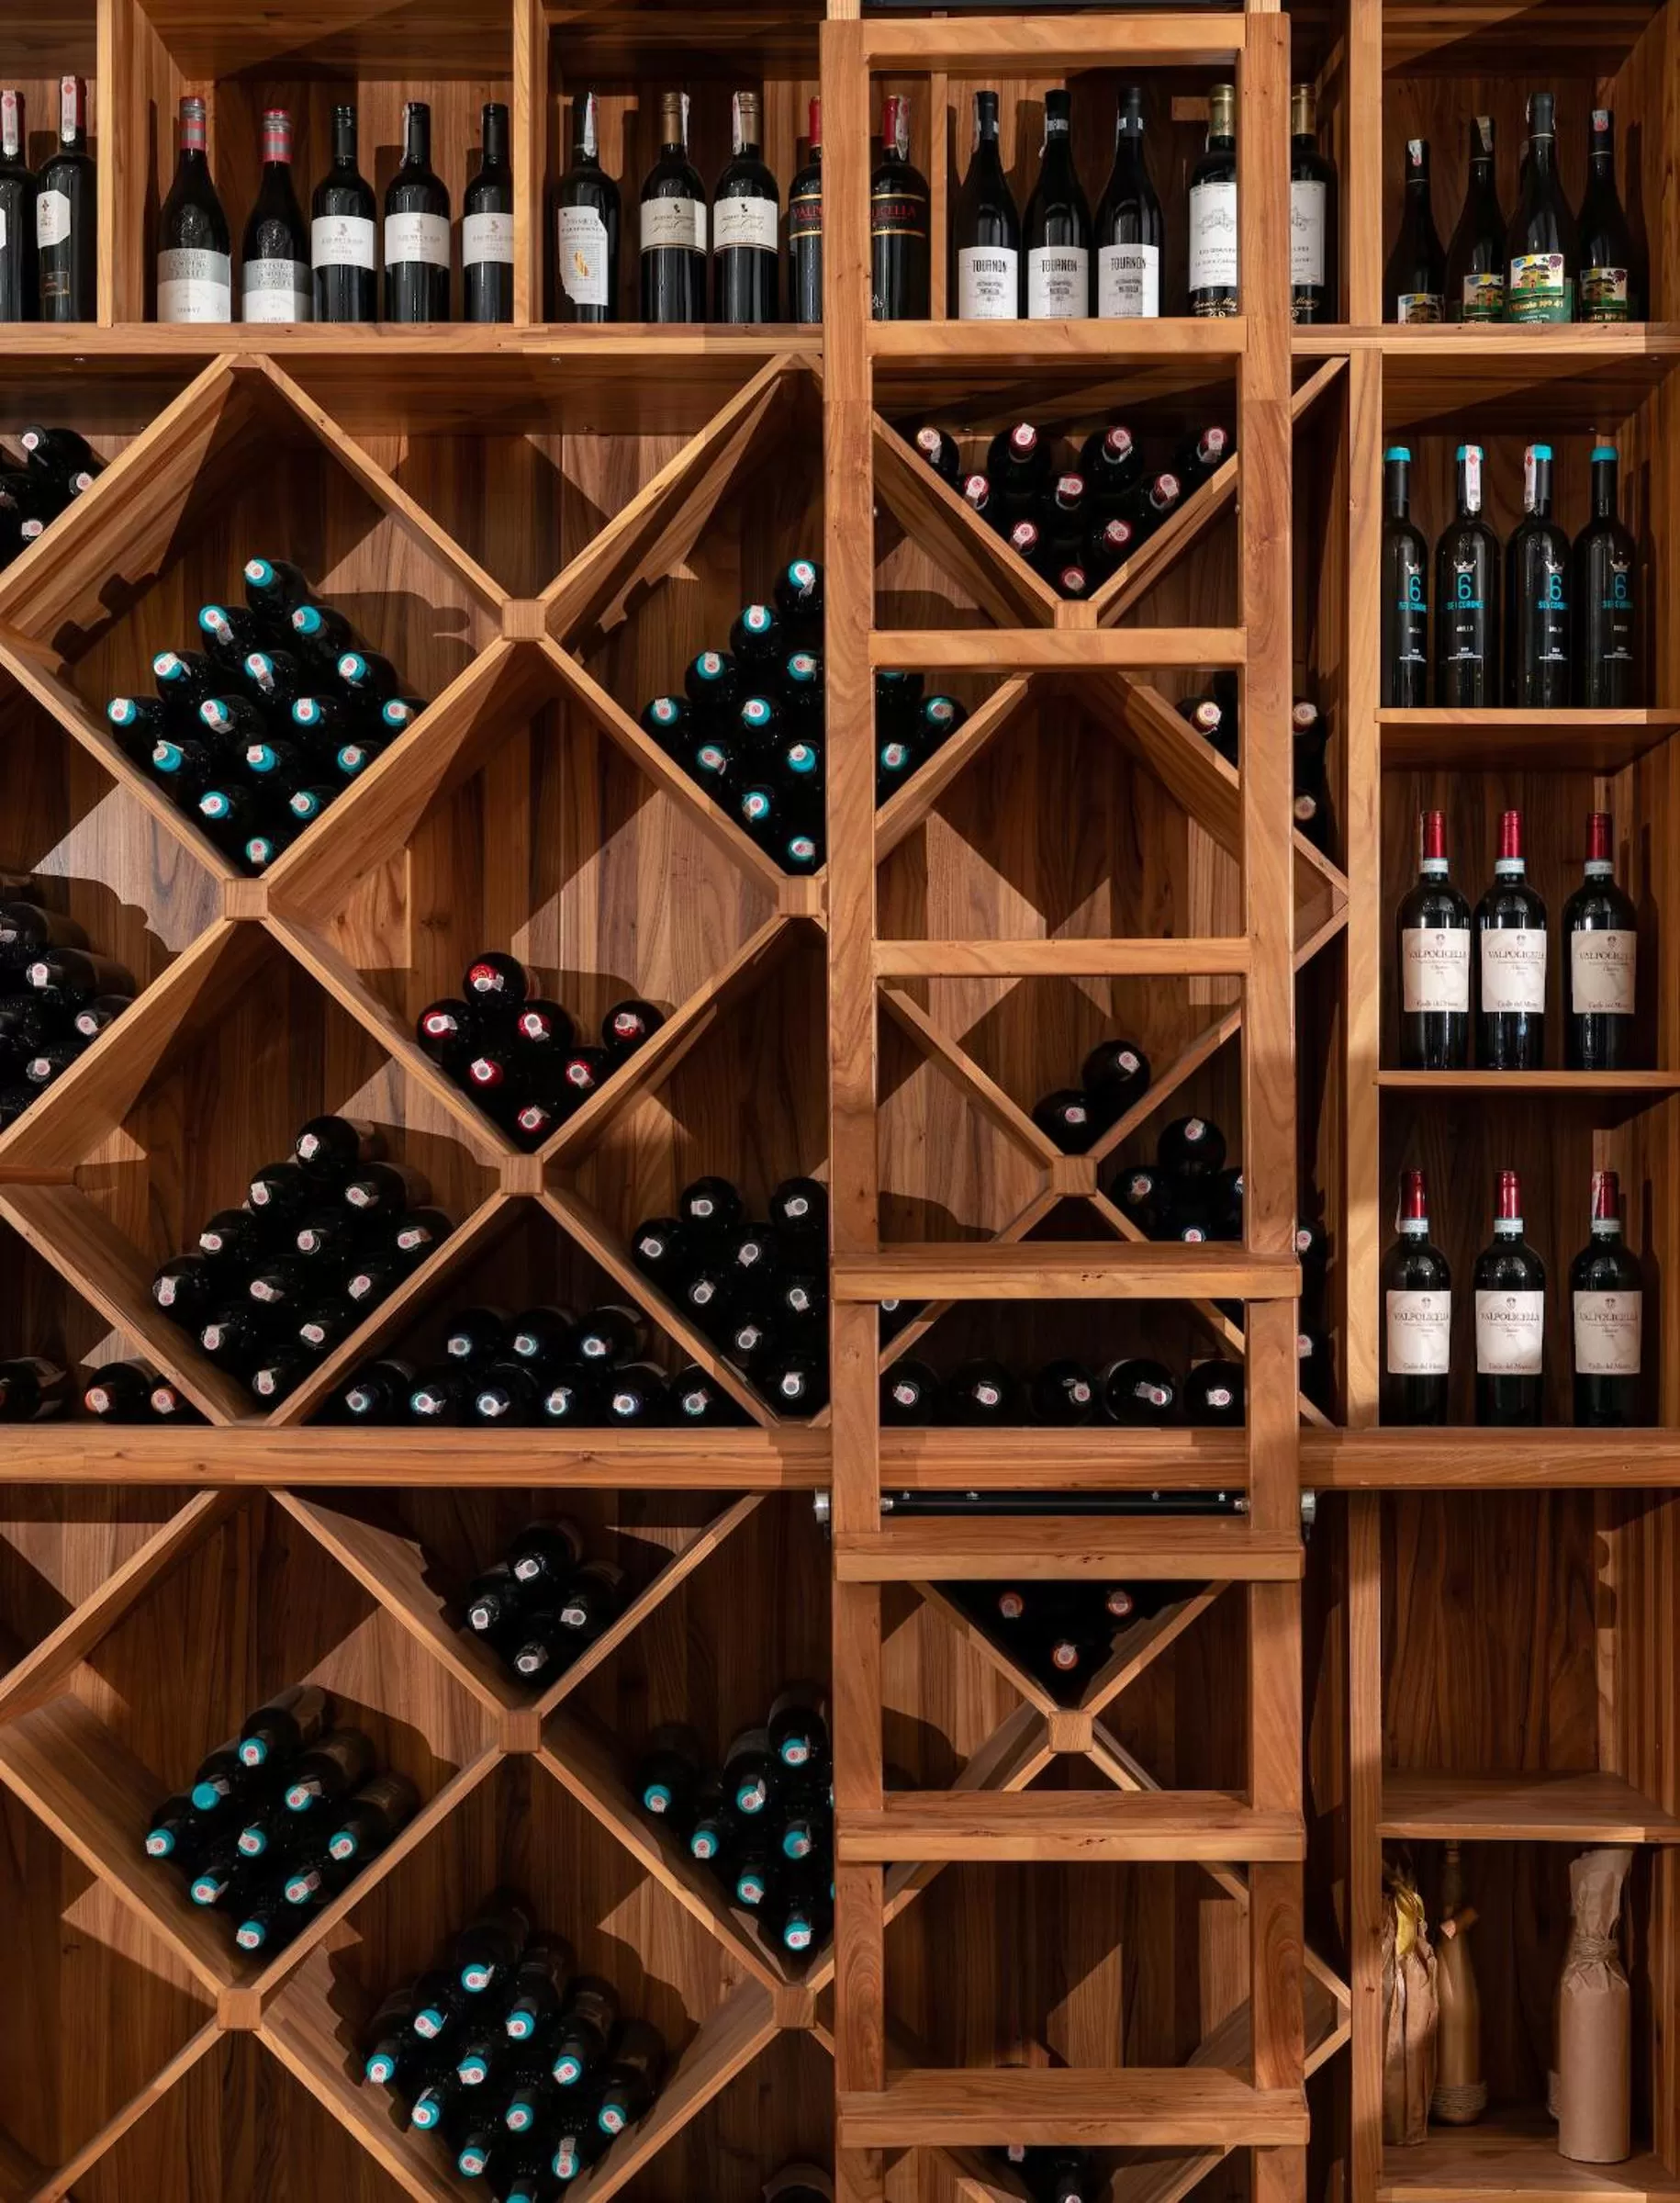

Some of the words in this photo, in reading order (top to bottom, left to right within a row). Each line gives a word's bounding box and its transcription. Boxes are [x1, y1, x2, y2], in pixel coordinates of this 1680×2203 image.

[972, 258, 1007, 274] TOURNON
[1041, 258, 1078, 274] TOURNON
[1110, 256, 1147, 271] TOURNON
[1410, 575, 1421, 601] 6
[1457, 573, 1472, 600] 6
[1550, 574, 1562, 601] 6
[1615, 573, 1627, 600] 6
